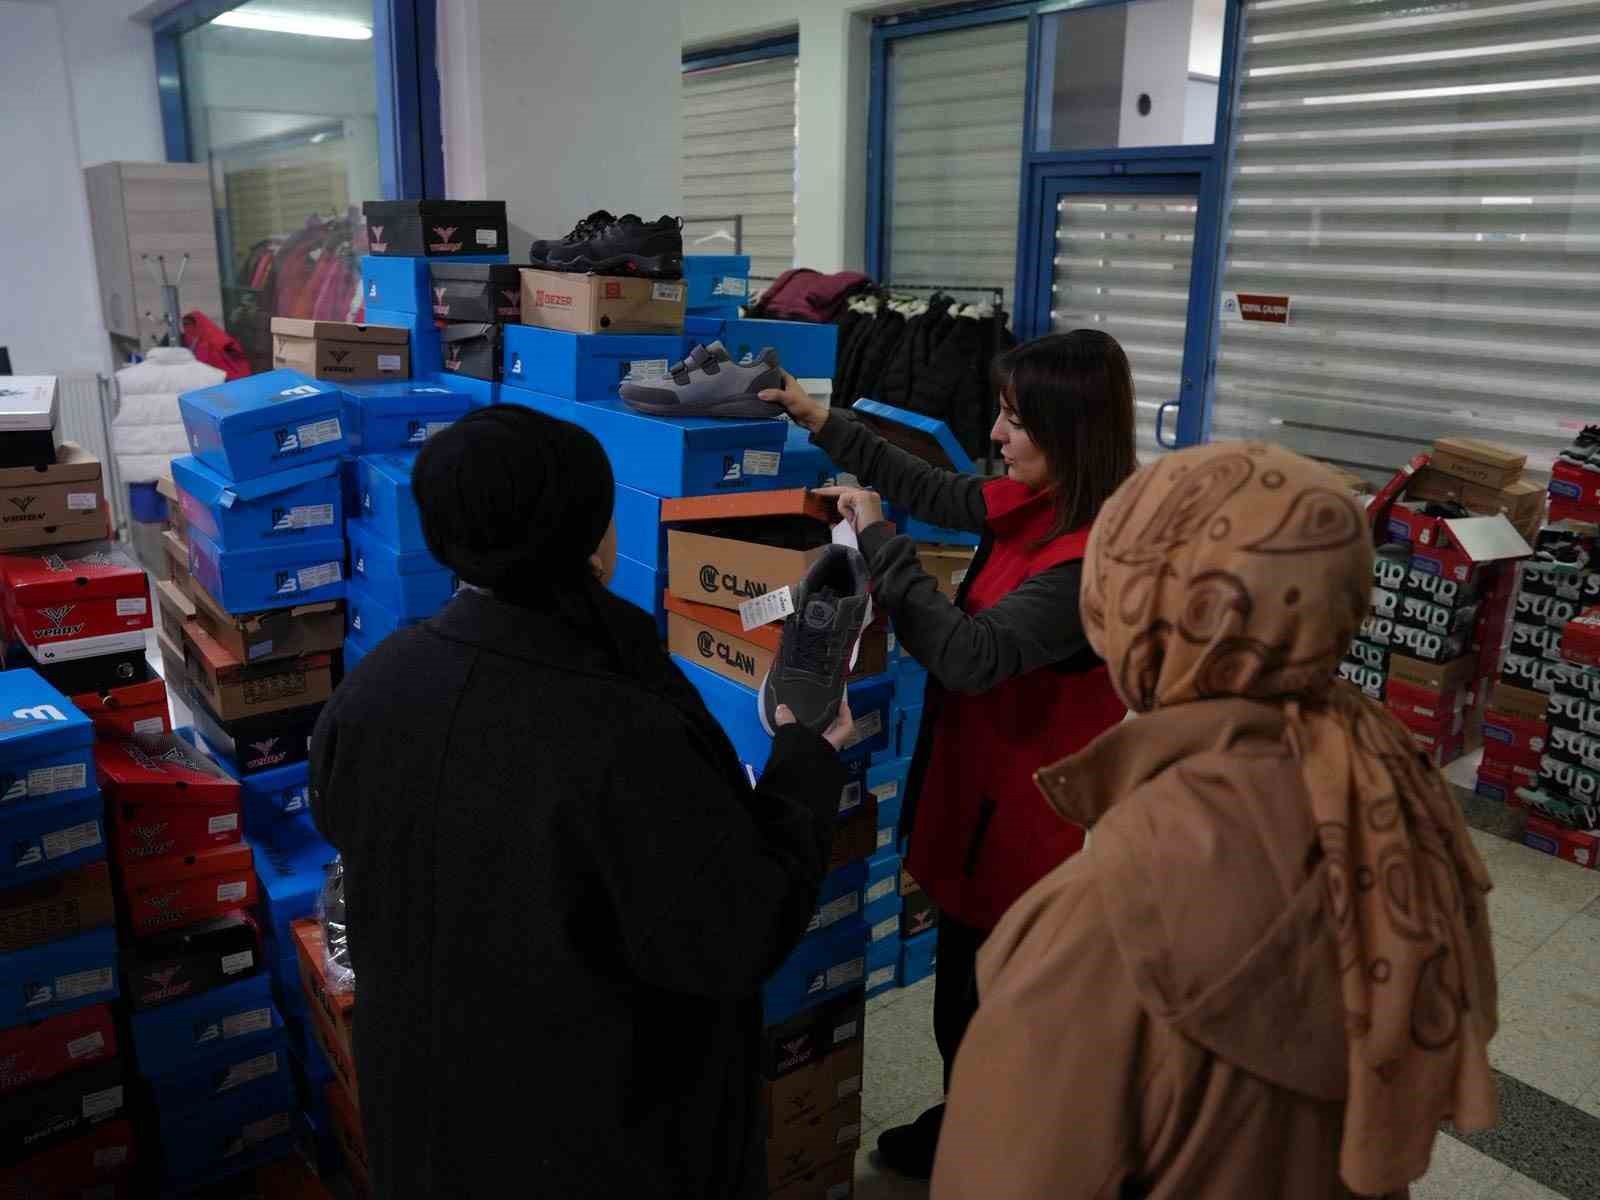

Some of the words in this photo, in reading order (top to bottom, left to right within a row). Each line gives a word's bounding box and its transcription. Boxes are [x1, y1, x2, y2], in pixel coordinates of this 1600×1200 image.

[722, 574, 767, 598] CLAW
[1402, 597, 1449, 626] sup
[1516, 593, 1574, 621] sup
[1392, 624, 1441, 649] sup
[716, 643, 755, 677] CLAW
[1338, 662, 1382, 689] sup
[1539, 754, 1595, 795] sup
